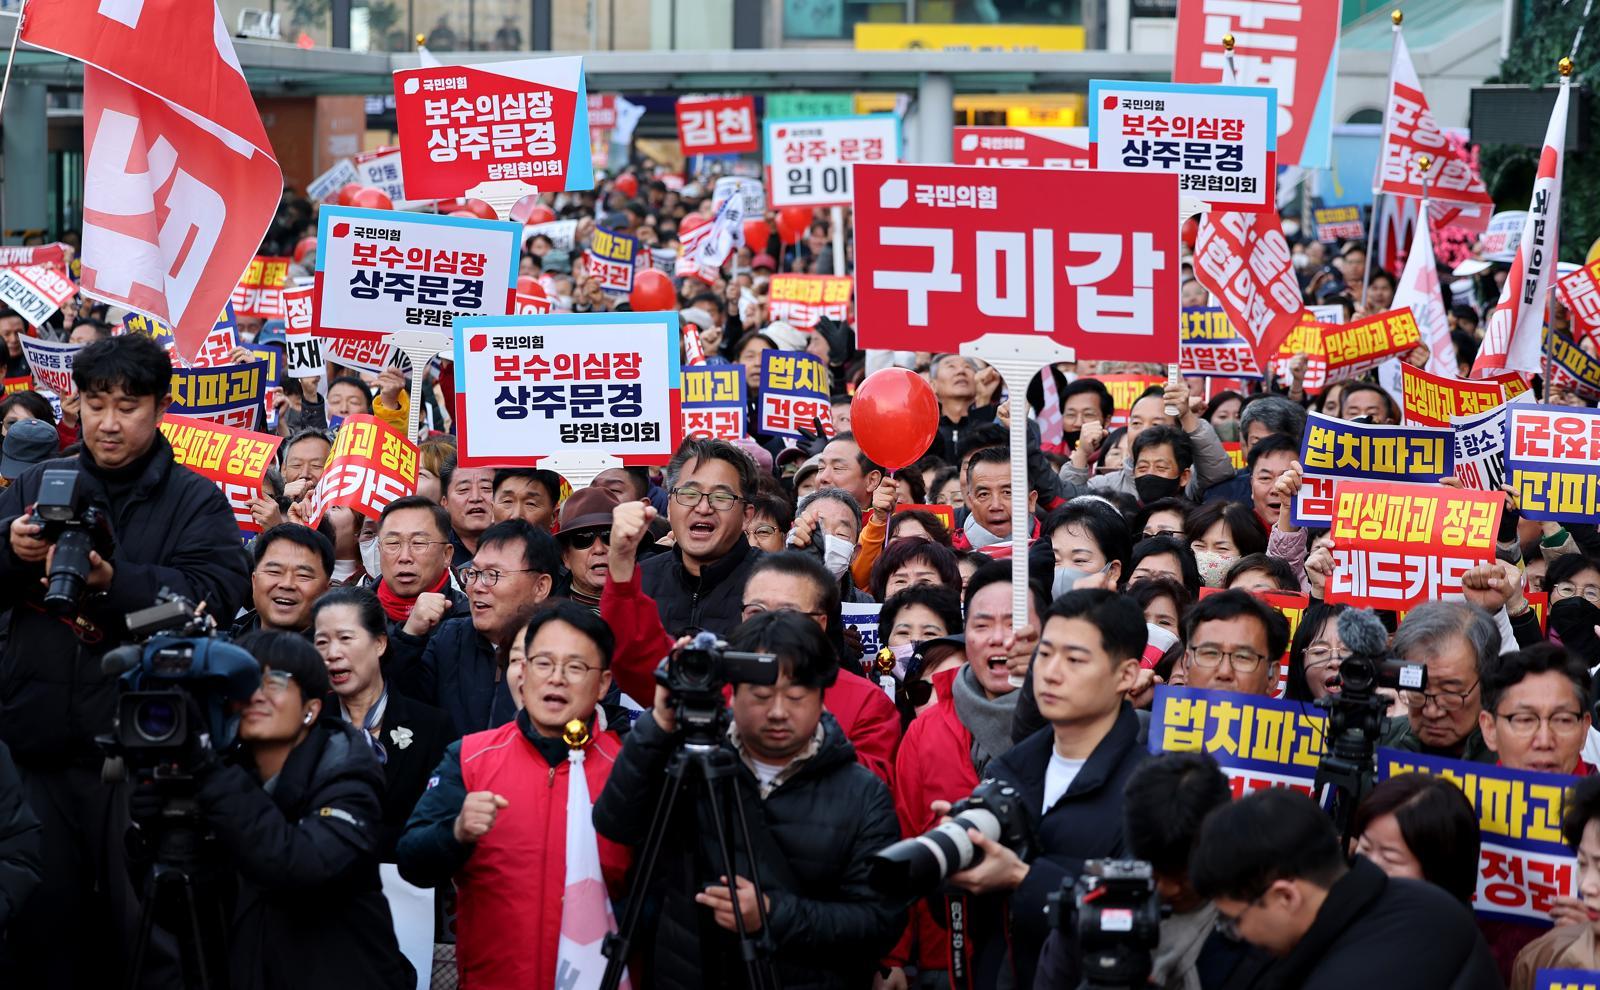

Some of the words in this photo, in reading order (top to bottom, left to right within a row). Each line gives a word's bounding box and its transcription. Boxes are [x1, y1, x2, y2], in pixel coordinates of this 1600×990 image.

[423, 77, 467, 91] 국민의힘
[425, 91, 553, 126] 보수의심장
[1122, 99, 1165, 111] 국민의힘
[427, 122, 557, 162] 상주문경
[680, 107, 753, 147] 김천
[1121, 114, 1245, 141] 보수의심장
[487, 160, 562, 180] 당원협의회
[1121, 140, 1244, 172] 상주문경
[788, 168, 812, 195] 임
[915, 184, 997, 209] 국민의힘
[354, 226, 401, 241] 국민의힘
[592, 229, 633, 261] 파괴
[1524, 189, 1550, 305] 국민의힘
[352, 243, 487, 277] 보수의심장
[590, 260, 631, 287] 정권
[350, 269, 484, 309] 상주문경
[873, 226, 1166, 336] 구미갑
[492, 336, 544, 349] 국민의힘
[1325, 321, 1389, 364] 민생파괴
[1387, 313, 1420, 347] 정권
[28, 351, 60, 368] 대장동
[493, 352, 642, 382] 보수의심장
[169, 368, 260, 407] 치파괴
[494, 383, 643, 419] 상주문경
[1402, 372, 1456, 422] 민생파괴
[559, 422, 660, 443] 당원협의회
[1305, 425, 1444, 474] 법치파괴
[1463, 429, 1498, 457] 항소
[226, 438, 275, 479] 정권
[380, 431, 418, 485] 정권
[1335, 492, 1439, 544] 민생파괴
[1441, 499, 1498, 548] 정권
[1478, 850, 1572, 914] 정권
